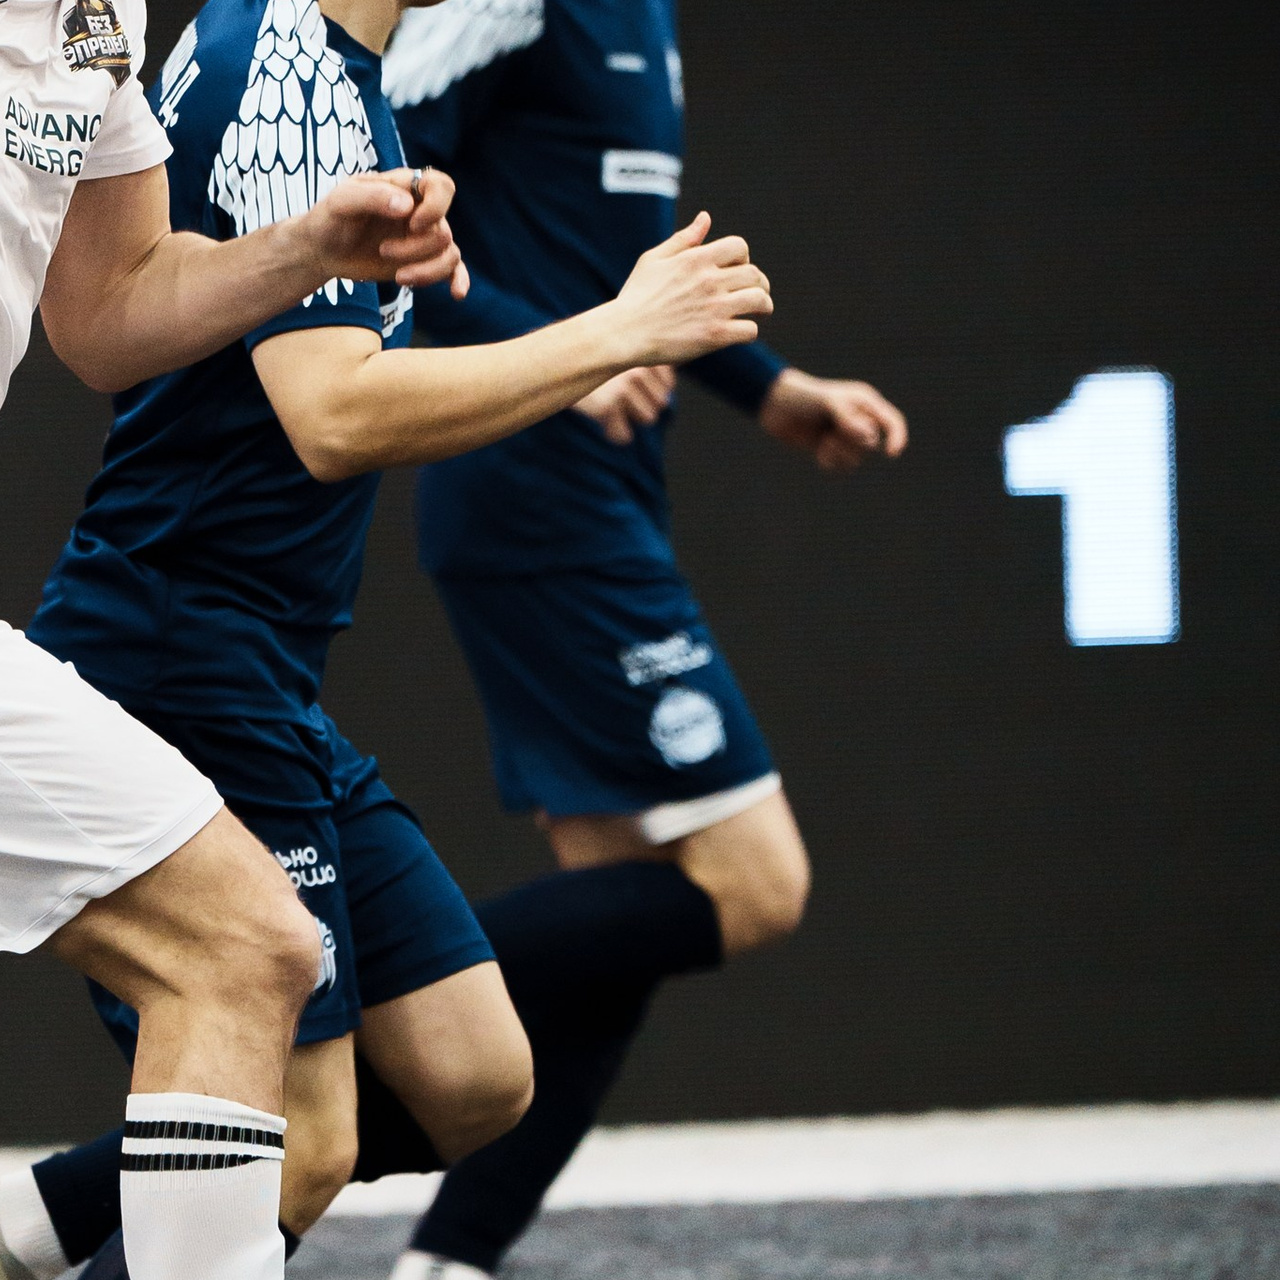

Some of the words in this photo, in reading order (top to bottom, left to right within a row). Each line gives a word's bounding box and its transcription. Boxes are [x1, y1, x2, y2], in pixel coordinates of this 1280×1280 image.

[85, 14, 114, 36] БЕЗ
[5, 95, 102, 142] ADVANC
[4, 128, 84, 177] ENERG
[1001, 365, 1180, 647] 1
